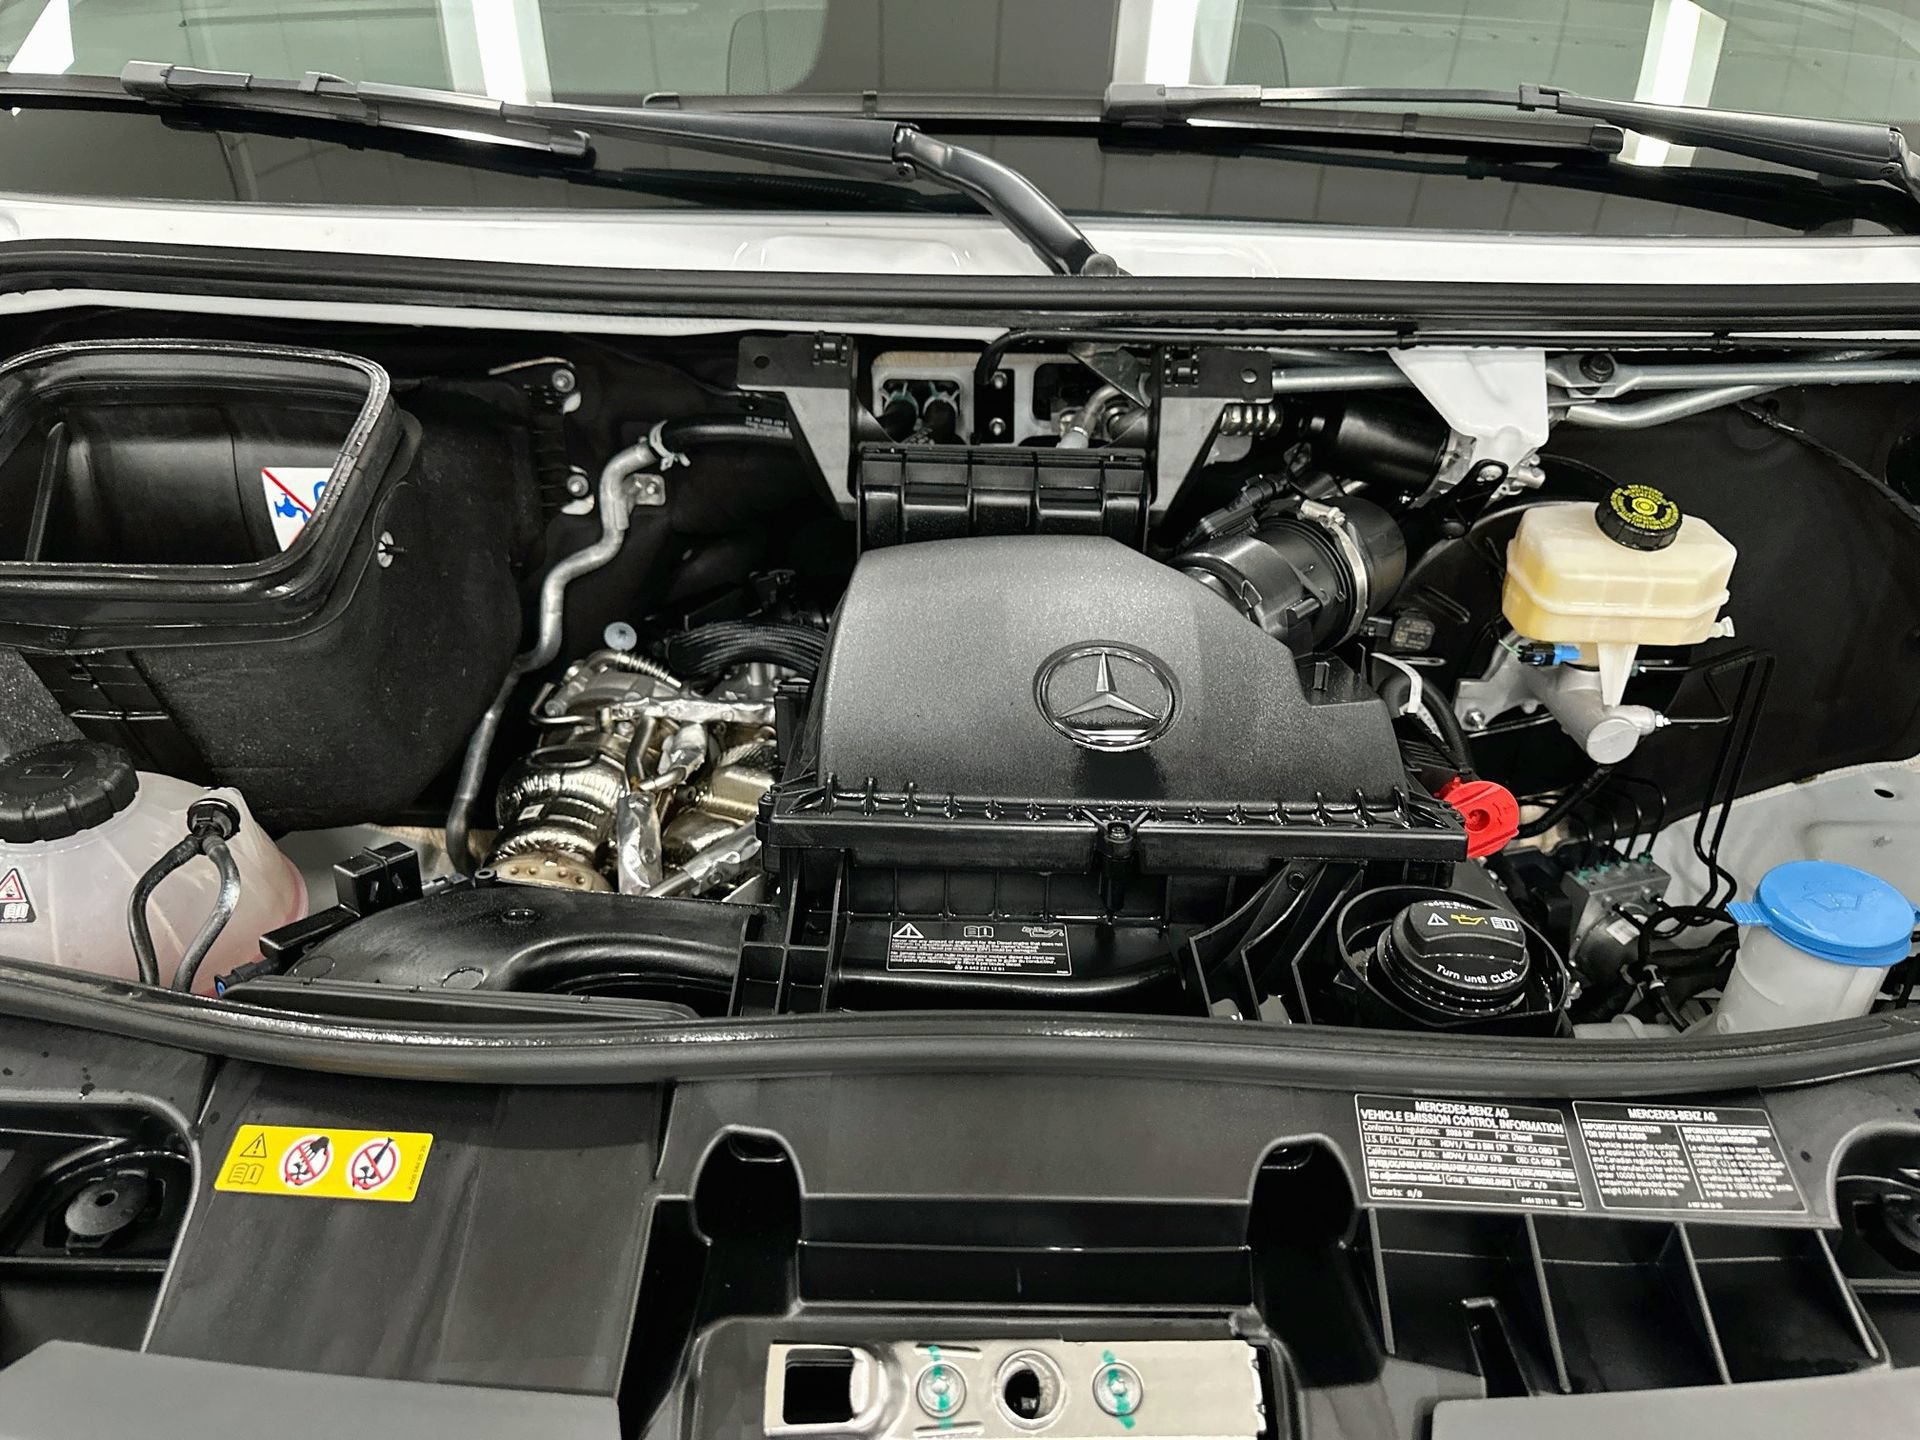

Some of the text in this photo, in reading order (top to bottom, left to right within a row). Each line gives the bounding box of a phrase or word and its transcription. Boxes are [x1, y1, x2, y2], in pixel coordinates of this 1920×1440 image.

[1437, 964, 1518, 984] Turn until CLICK
[1415, 1101, 1509, 1118] MERCEDES-BENZ AG
[1627, 1108, 1717, 1122] MERCEDES-BENZ AG
[1360, 1109, 1564, 1134] VEHICLE EMISSION CONTROL INFORMATION
[1363, 1123, 1394, 1132] Conforms
[1395, 1125, 1402, 1133] to
[1404, 1126, 1440, 1136] regulations:
[1582, 1123, 1661, 1133] IMPORTANT INFORMATION
[1364, 1135, 1378, 1143] U.S.
[1380, 1136, 1394, 1144] EPA
[1366, 1146, 1397, 1156] California
[1528, 1146, 1538, 1154] CA
[1531, 1157, 1540, 1165] CA
[1372, 1187, 1422, 1198] Remarks: n/a
